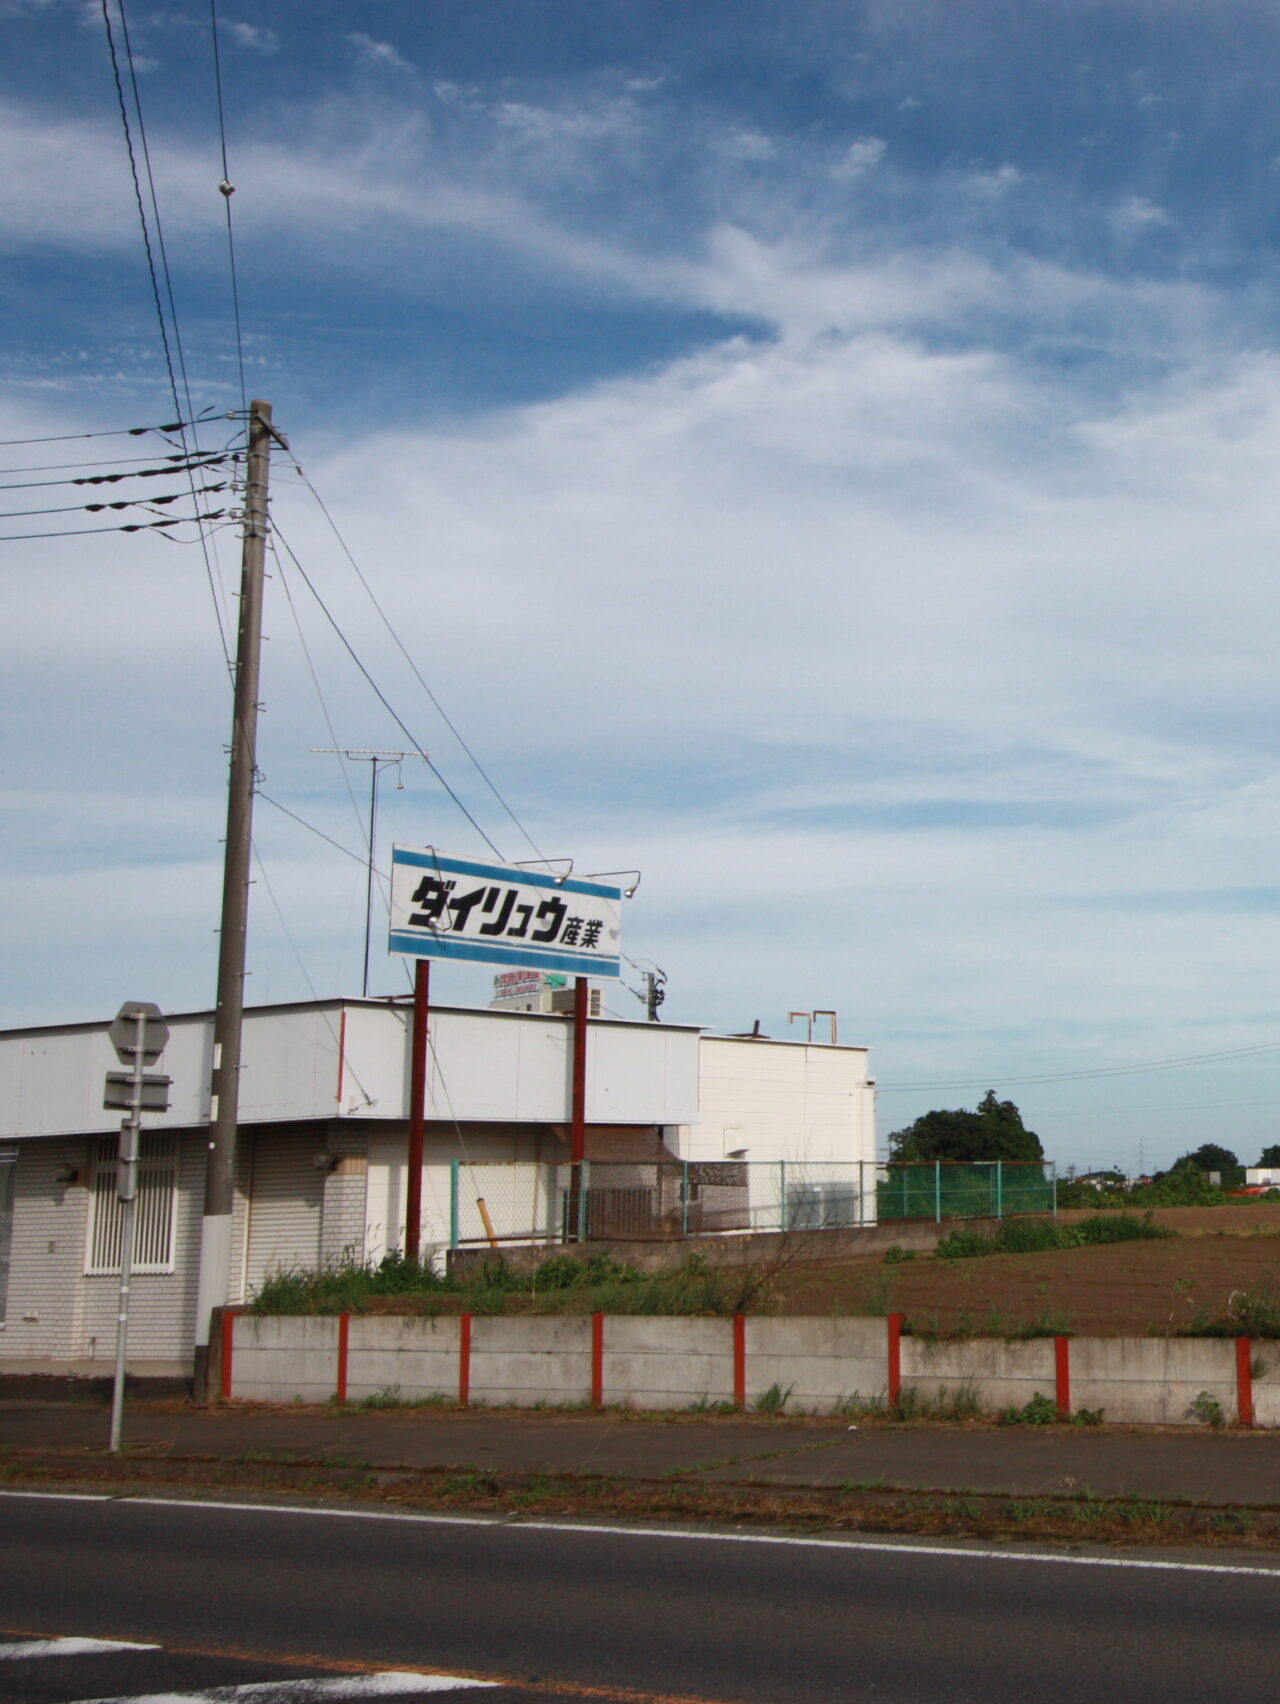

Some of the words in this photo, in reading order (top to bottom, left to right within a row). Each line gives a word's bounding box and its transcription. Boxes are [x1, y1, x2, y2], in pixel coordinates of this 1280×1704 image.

[408, 876, 604, 949] ダイリュウ産業
